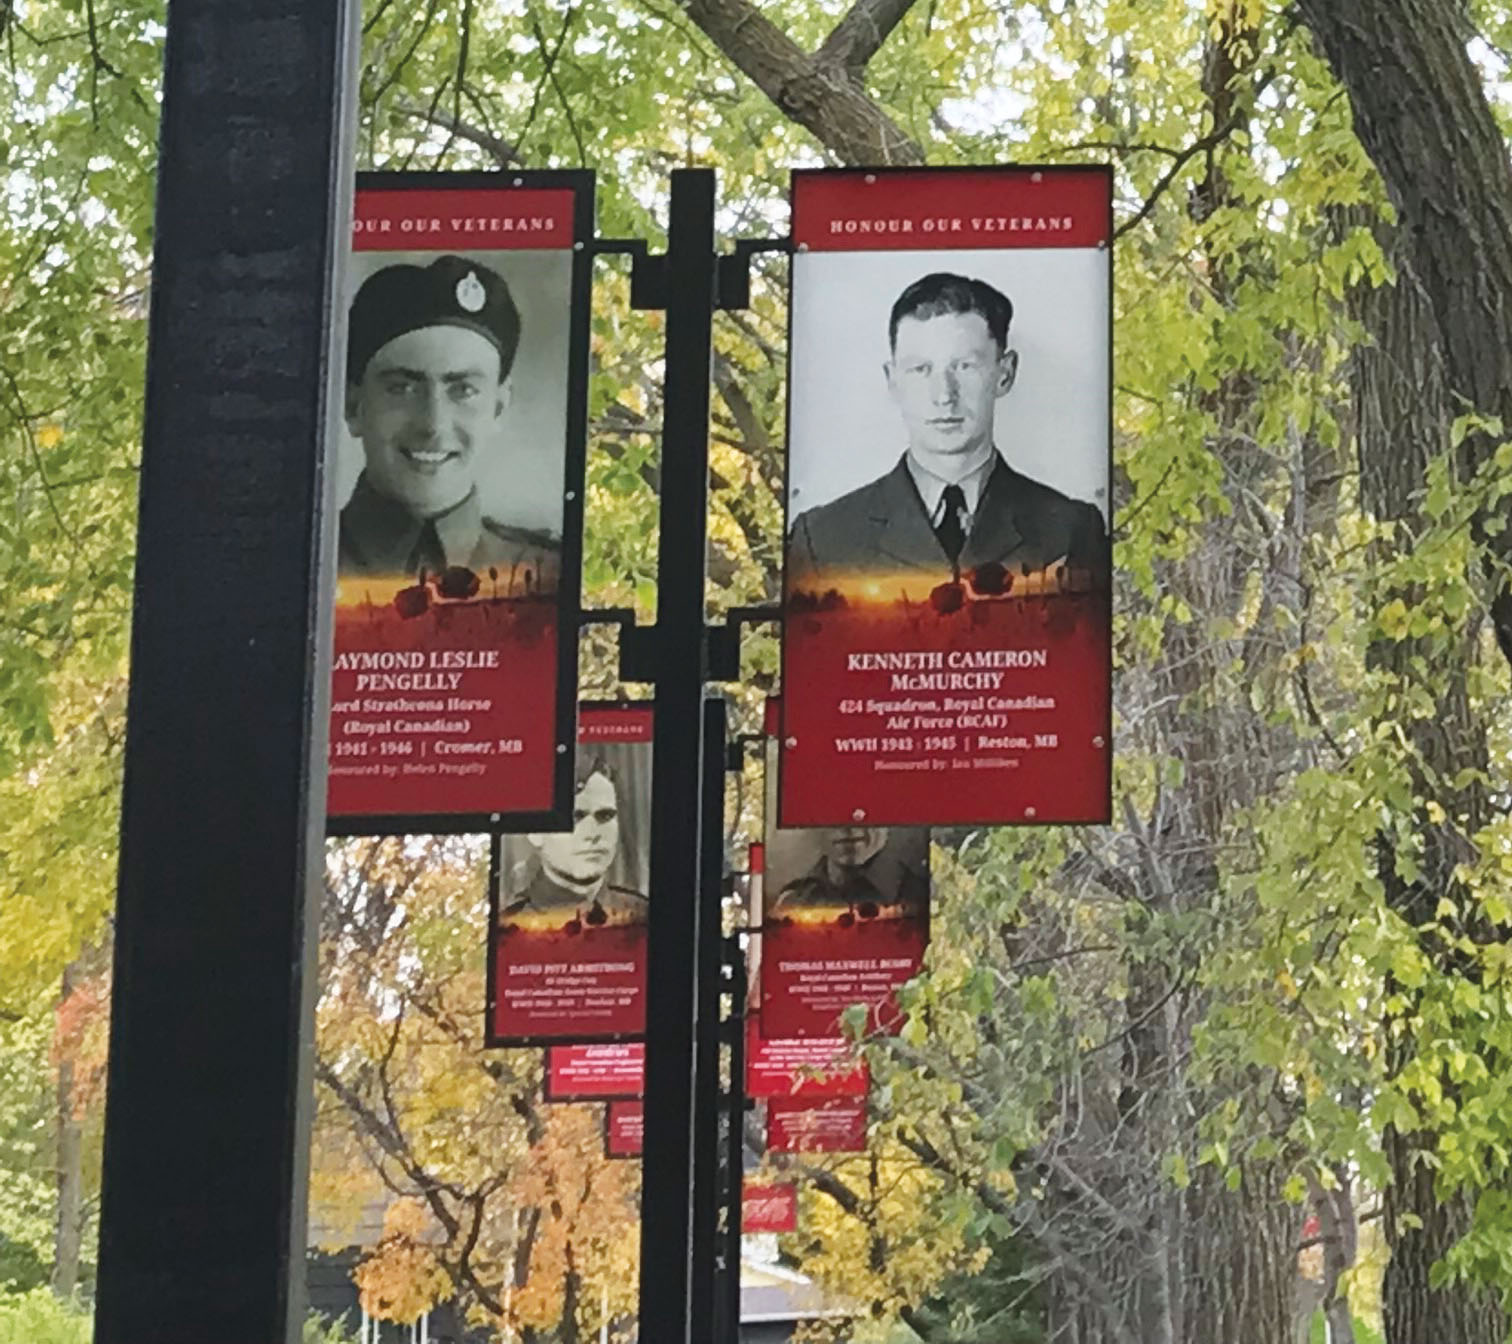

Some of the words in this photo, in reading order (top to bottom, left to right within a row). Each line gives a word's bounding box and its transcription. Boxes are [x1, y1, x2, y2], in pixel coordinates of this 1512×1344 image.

[354, 220, 390, 232] OUR
[400, 219, 441, 232] OUR
[451, 218, 554, 231] VETERANS
[830, 220, 913, 233] HONOUR
[922, 219, 961, 231] OUR
[972, 217, 1072, 231] VETERANS
[332, 652, 425, 670] AYMOND
[430, 651, 499, 668] LESLIE
[848, 652, 942, 671] KENNETH
[948, 650, 1047, 667] CAMERON
[356, 673, 462, 691] PENGELLY
[891, 673, 1004, 691] McMURCHY
[332, 699, 360, 712] ord
[448, 698, 491, 711] Horse
[839, 701, 863, 713] 424
[867, 699, 940, 716] Squadron,
[944, 697, 983, 714] Royal
[987, 696, 1055, 710] Canadian
[344, 720, 391, 736] (Royal
[394, 720, 470, 733] Canadian)
[887, 717, 910, 730] Air
[913, 716, 953, 729] Force
[957, 715, 1006, 729] (RCAF)
[336, 742, 367, 756] 1941
[498, 740, 522, 753] MB
[836, 739, 877, 752] WWII
[978, 736, 1030, 749] Reston,
[1035, 735, 1057, 747] MB
